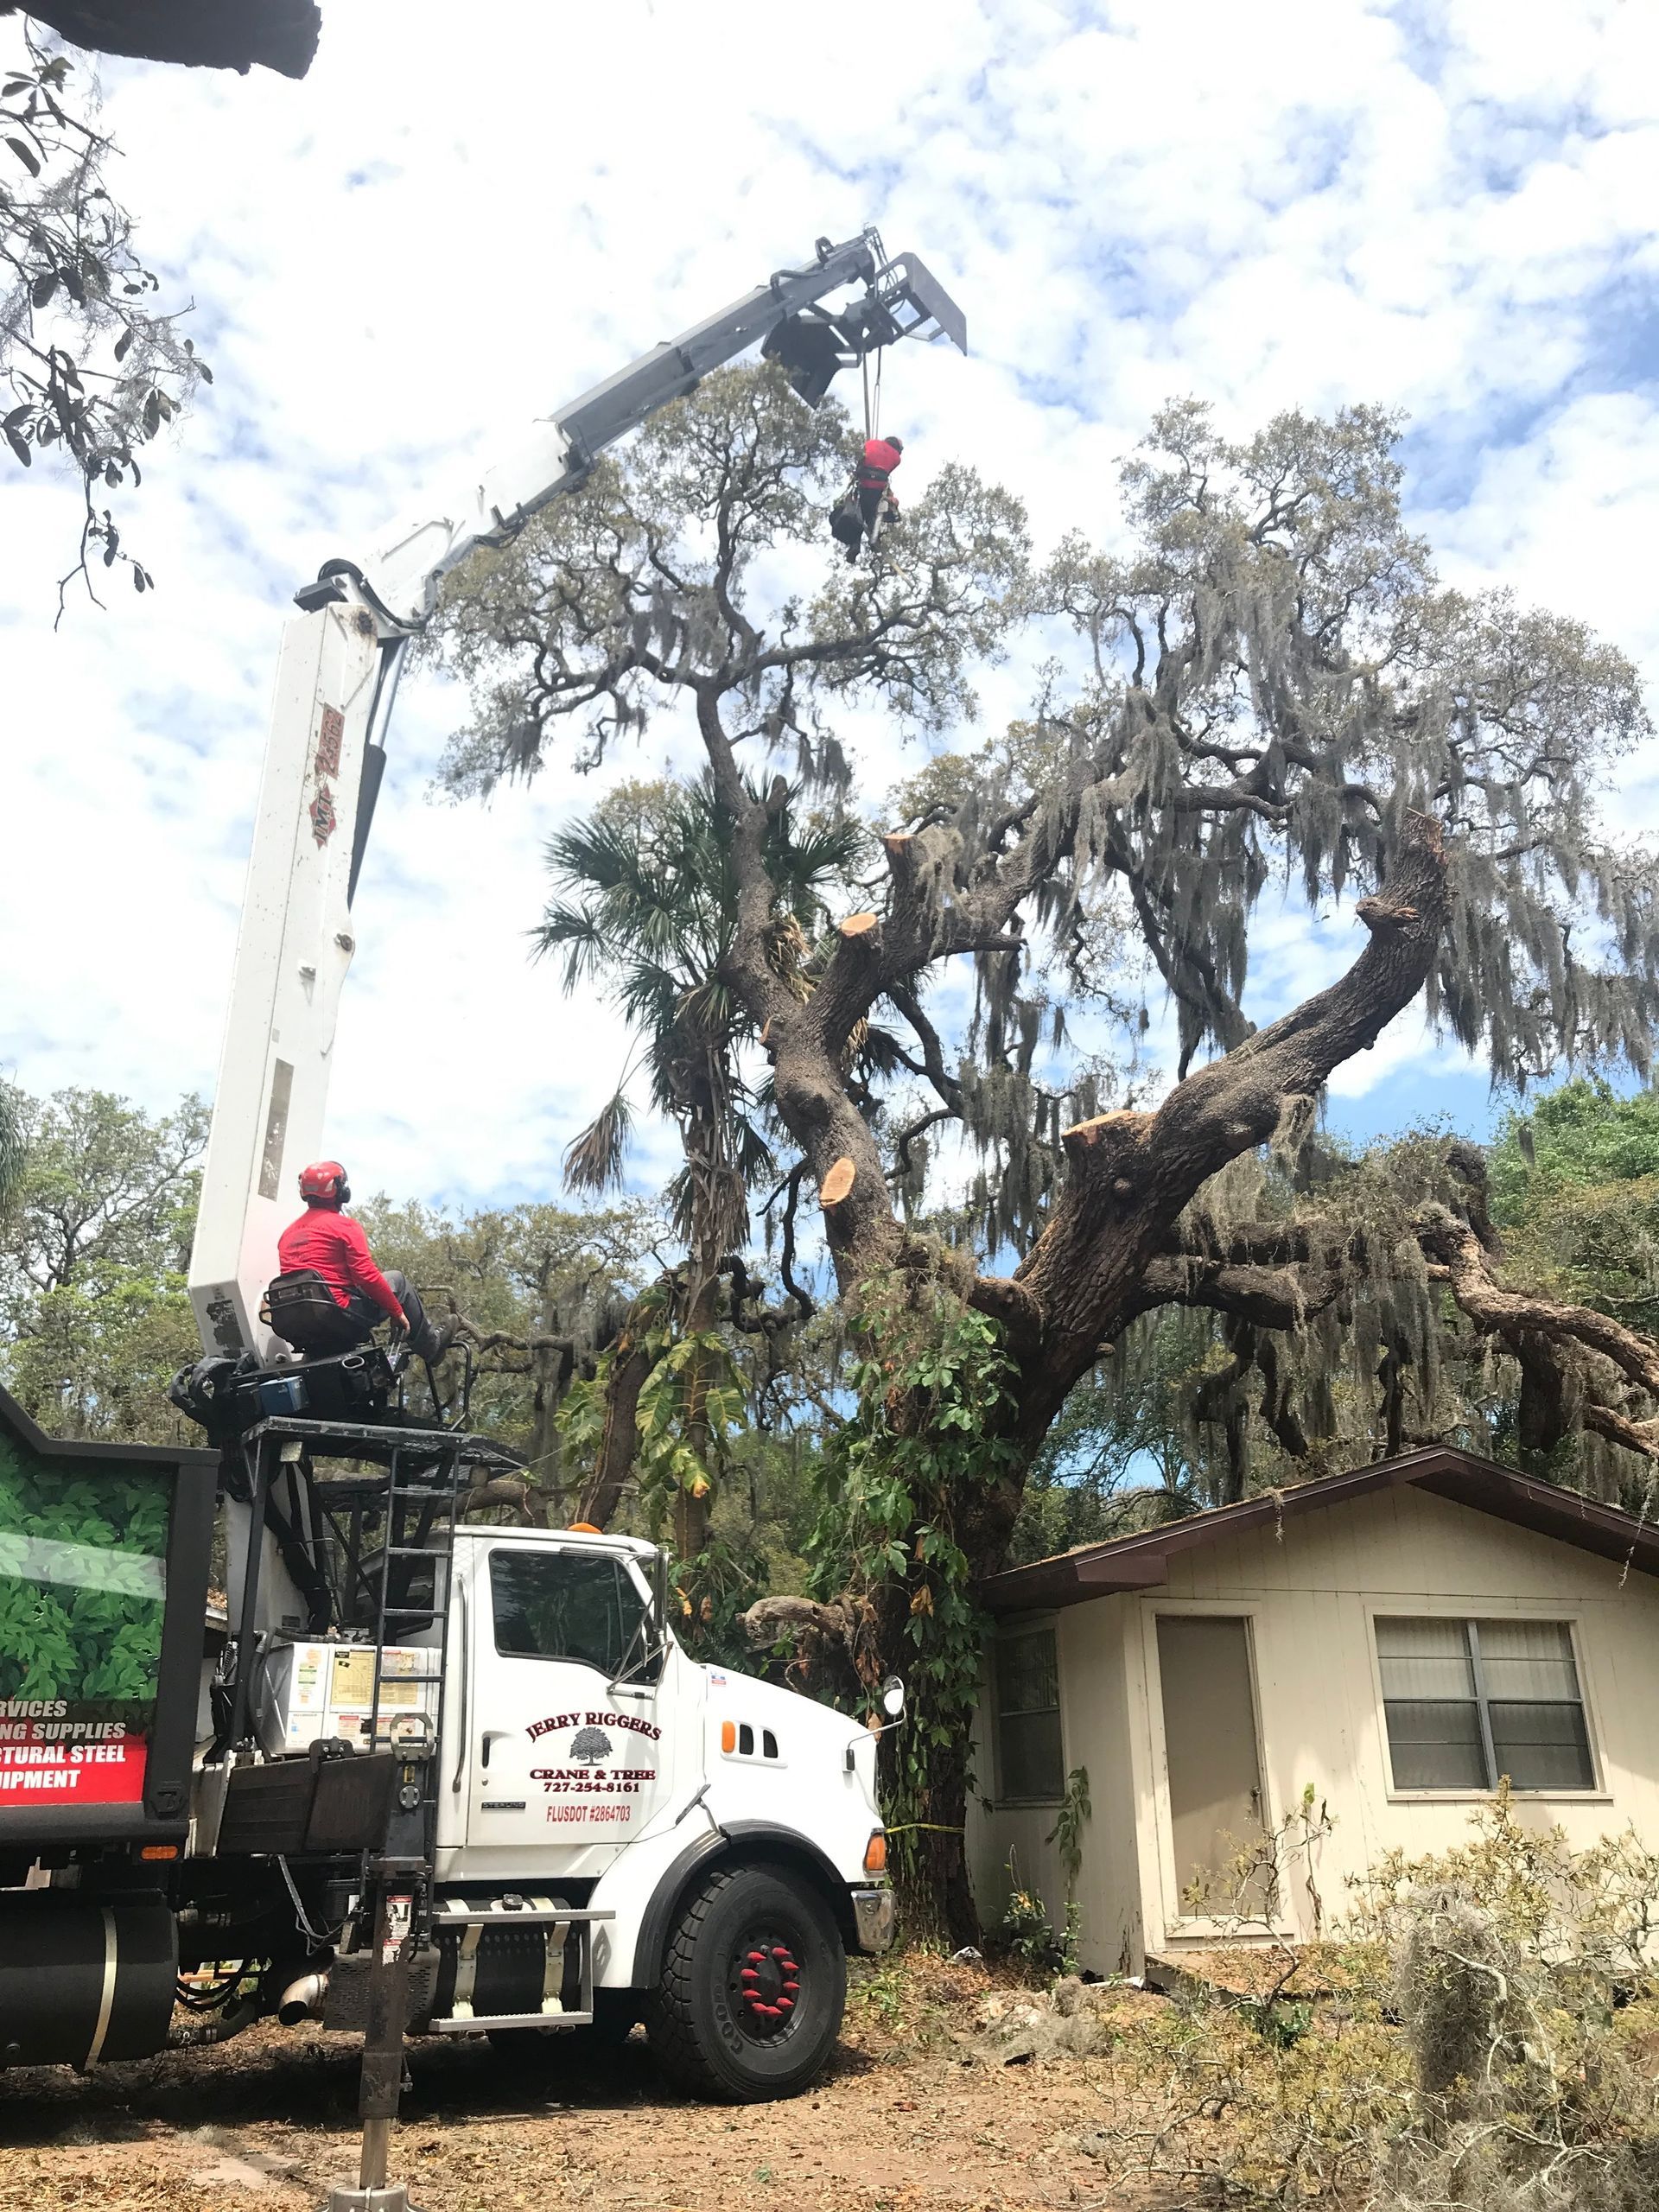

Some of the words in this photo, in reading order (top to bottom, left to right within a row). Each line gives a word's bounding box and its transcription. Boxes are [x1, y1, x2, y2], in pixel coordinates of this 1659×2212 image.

[314, 790, 333, 844] IMT
[31, 1722, 126, 1740] SUPPLIES
[525, 1713, 582, 1743] JERRY
[585, 1712, 663, 1741] RIGGERS
[0, 1745, 66, 1764] TURAL
[70, 1745, 126, 1764] STEEL
[0, 1769, 81, 1789] IPMENT
[530, 1769, 589, 1780] CRANE
[594, 1770, 607, 1780] &
[610, 1770, 656, 1780] TREE
[543, 1782, 639, 1792] 727-254-8161
[547, 1805, 588, 1822] FLUSDOT
[589, 1805, 631, 1821] #2864703
